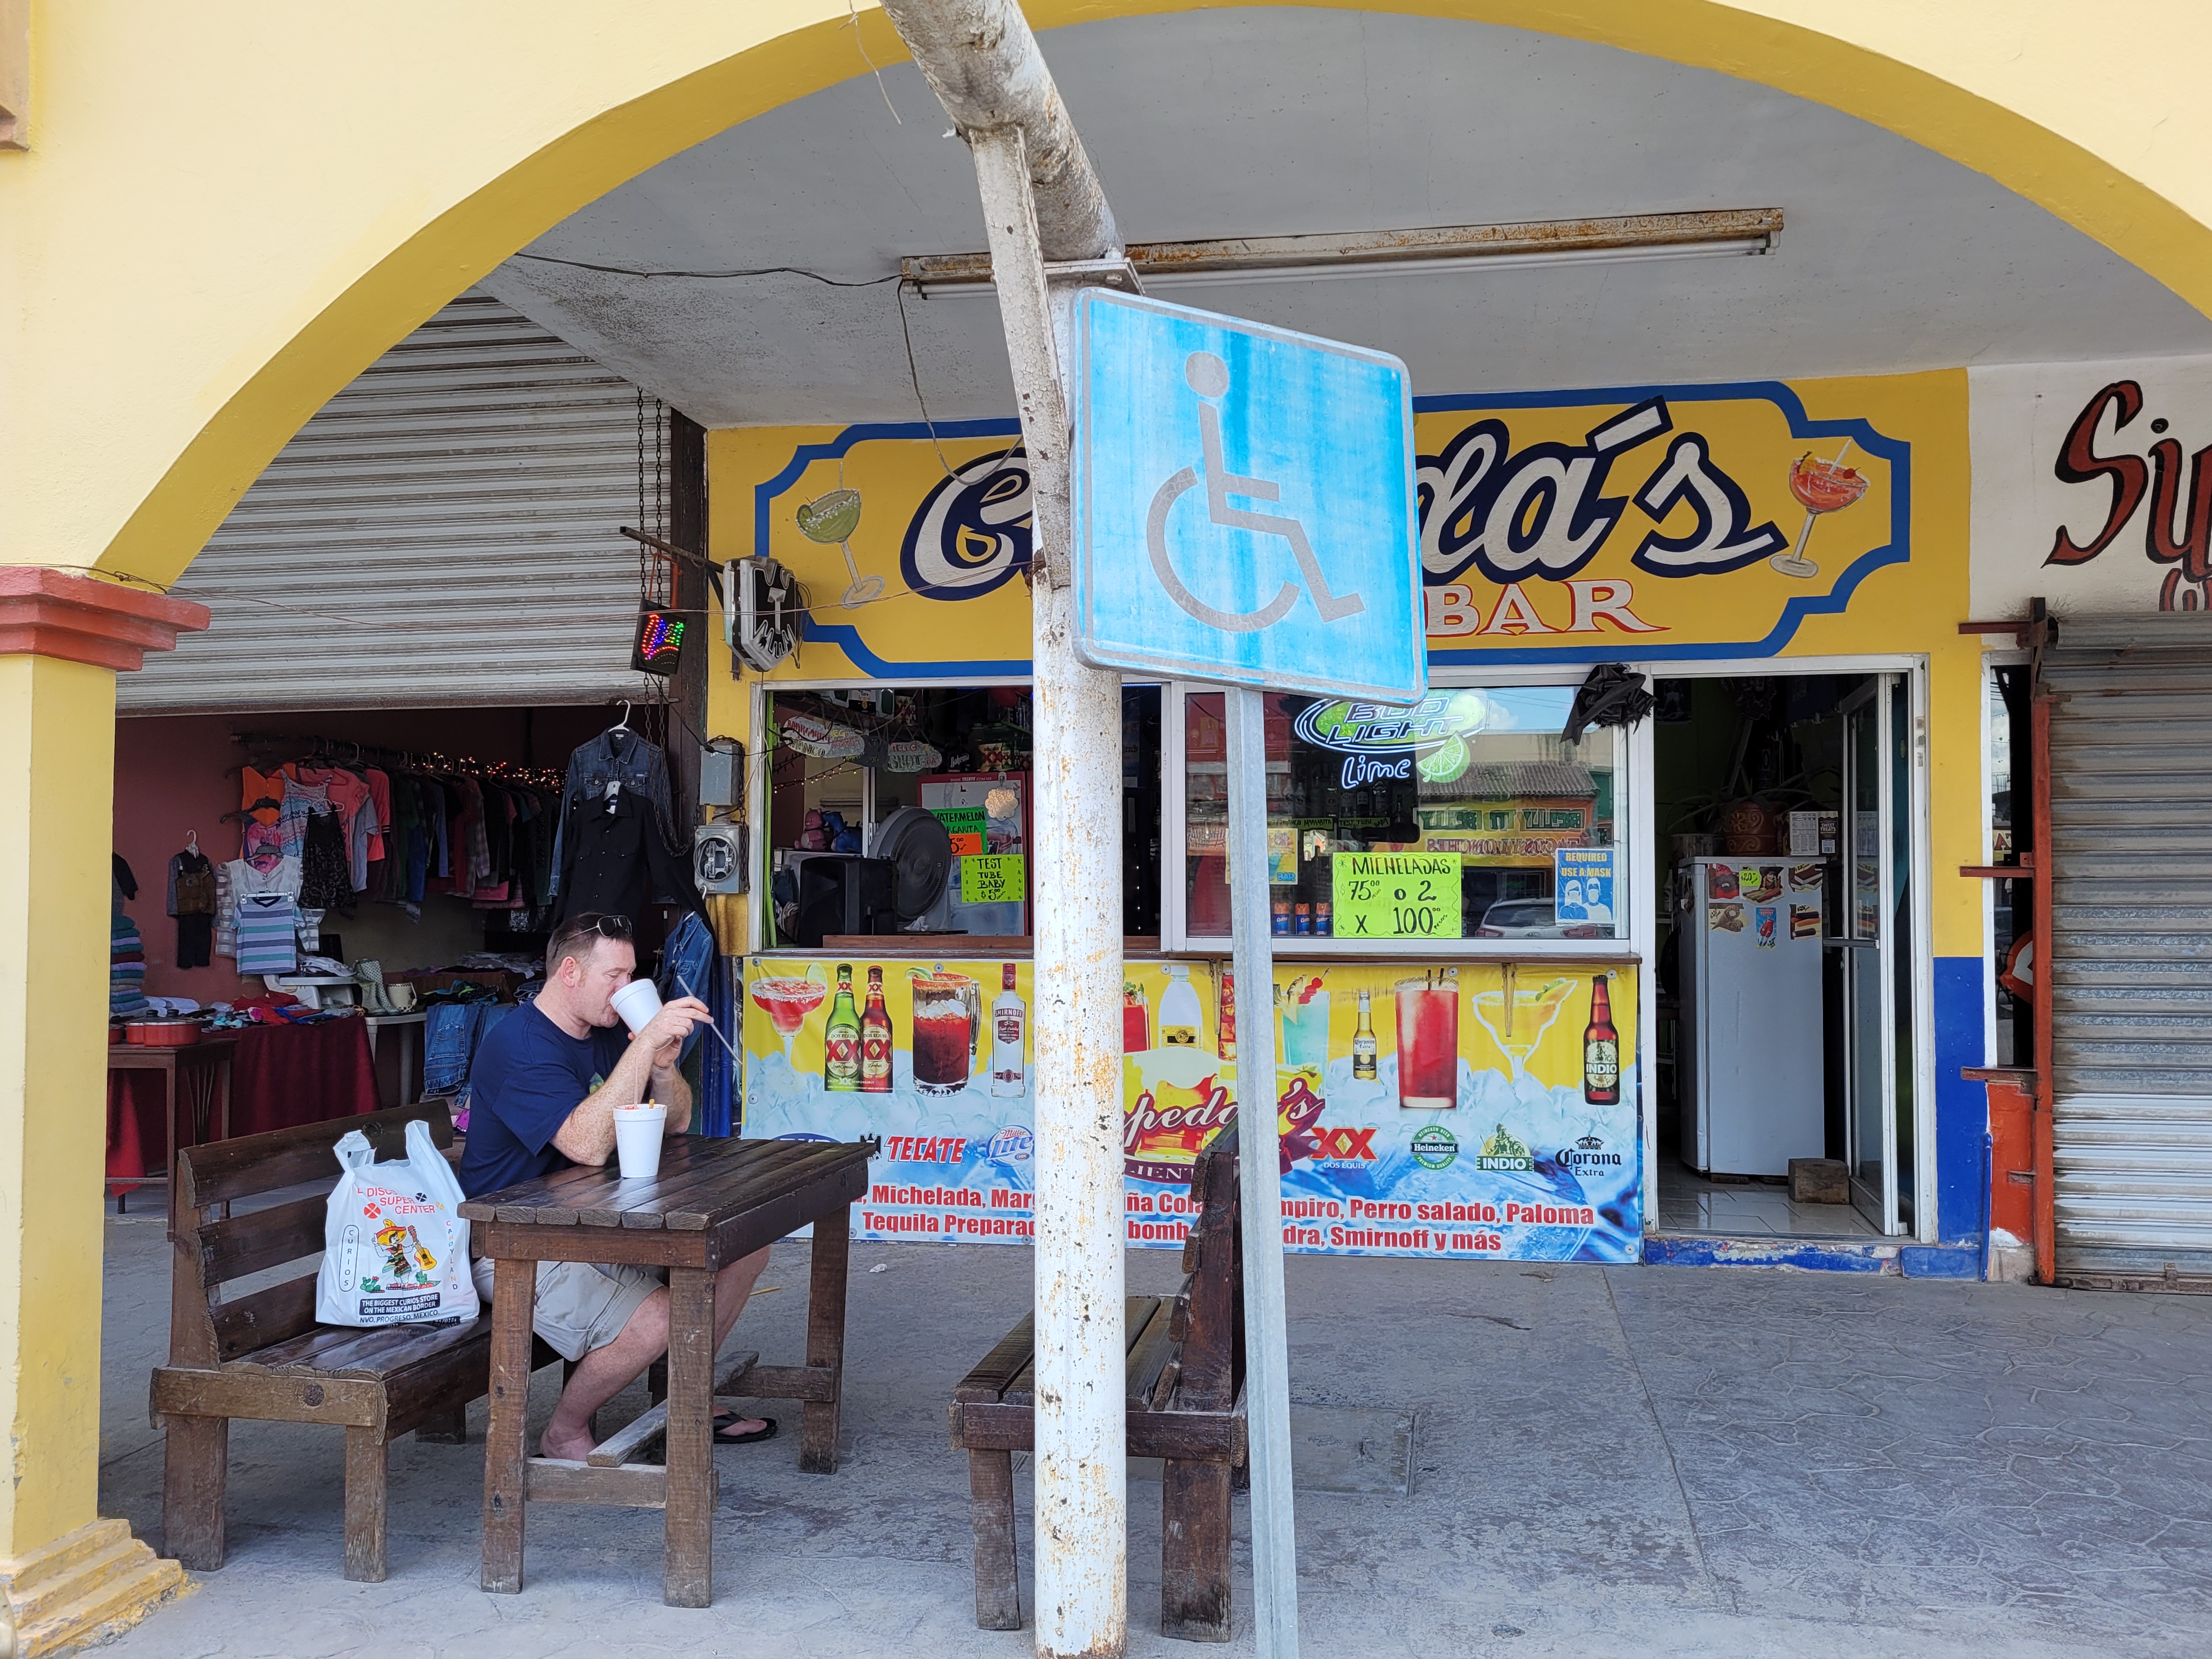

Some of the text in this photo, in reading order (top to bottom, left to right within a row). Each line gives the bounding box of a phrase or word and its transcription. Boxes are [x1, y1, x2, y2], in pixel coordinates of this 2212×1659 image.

[2040, 380, 2212, 583] Si
[1424, 578, 1672, 637] BAR
[1345, 696, 1451, 723] BUD
[1325, 715, 1464, 745] LIGHT
[1341, 755, 1411, 789] Lime
[947, 825, 979, 834] RGARITA
[977, 858, 1002, 870] TEST
[1566, 853, 1607, 862] REQUIRED
[1352, 857, 1451, 875] MICHELADAS
[1561, 868, 1611, 877] USE A MASK
[1277, 872, 1296, 882] BAR
[977, 879, 1006, 889] BABY
[1418, 880, 1437, 901] 2
[995, 1009, 1023, 1017] SMIRNOFF
[826, 1040, 861, 1063] XX
[1586, 1064, 1617, 1074] INDIO
[1000, 1128, 1027, 1138] Miller
[1418, 1126, 1451, 1138] HEINEKEN BEER
[885, 1135, 967, 1164] TECATE
[990, 1136, 1034, 1159] Lite
[1309, 1126, 1380, 1161] XX
[1414, 1143, 1455, 1152] Heineken
[1417, 1156, 1452, 1169] PREMIUM QUALITY
[1483, 1158, 1527, 1170] INDIO
[1555, 1148, 1622, 1170] Corona
[1575, 1166, 1605, 1176] Extra
[380, 1196, 415, 1206] SUPER
[872, 1185, 986, 1208] Michelada,
[394, 1205, 436, 1214] CENTER
[1350, 1199, 1412, 1221] Perro
[1417, 1201, 1501, 1224] salado,
[1506, 1203, 1594, 1224] Paloma
[862, 1212, 939, 1233] Tequila
[1330, 1226, 1429, 1248] Smirnoff
[1434, 1233, 1447, 1251] y
[1453, 1230, 1502, 1251] más
[343, 1229, 354, 1286] CURIOS
[446, 1220, 458, 1290] CANDYLAND
[420, 1294, 438, 1302] STORE
[413, 1301, 436, 1311] BORDER
[376, 1314, 412, 1323] PROGRESO.
[413, 1310, 440, 1320] MEXICO.
